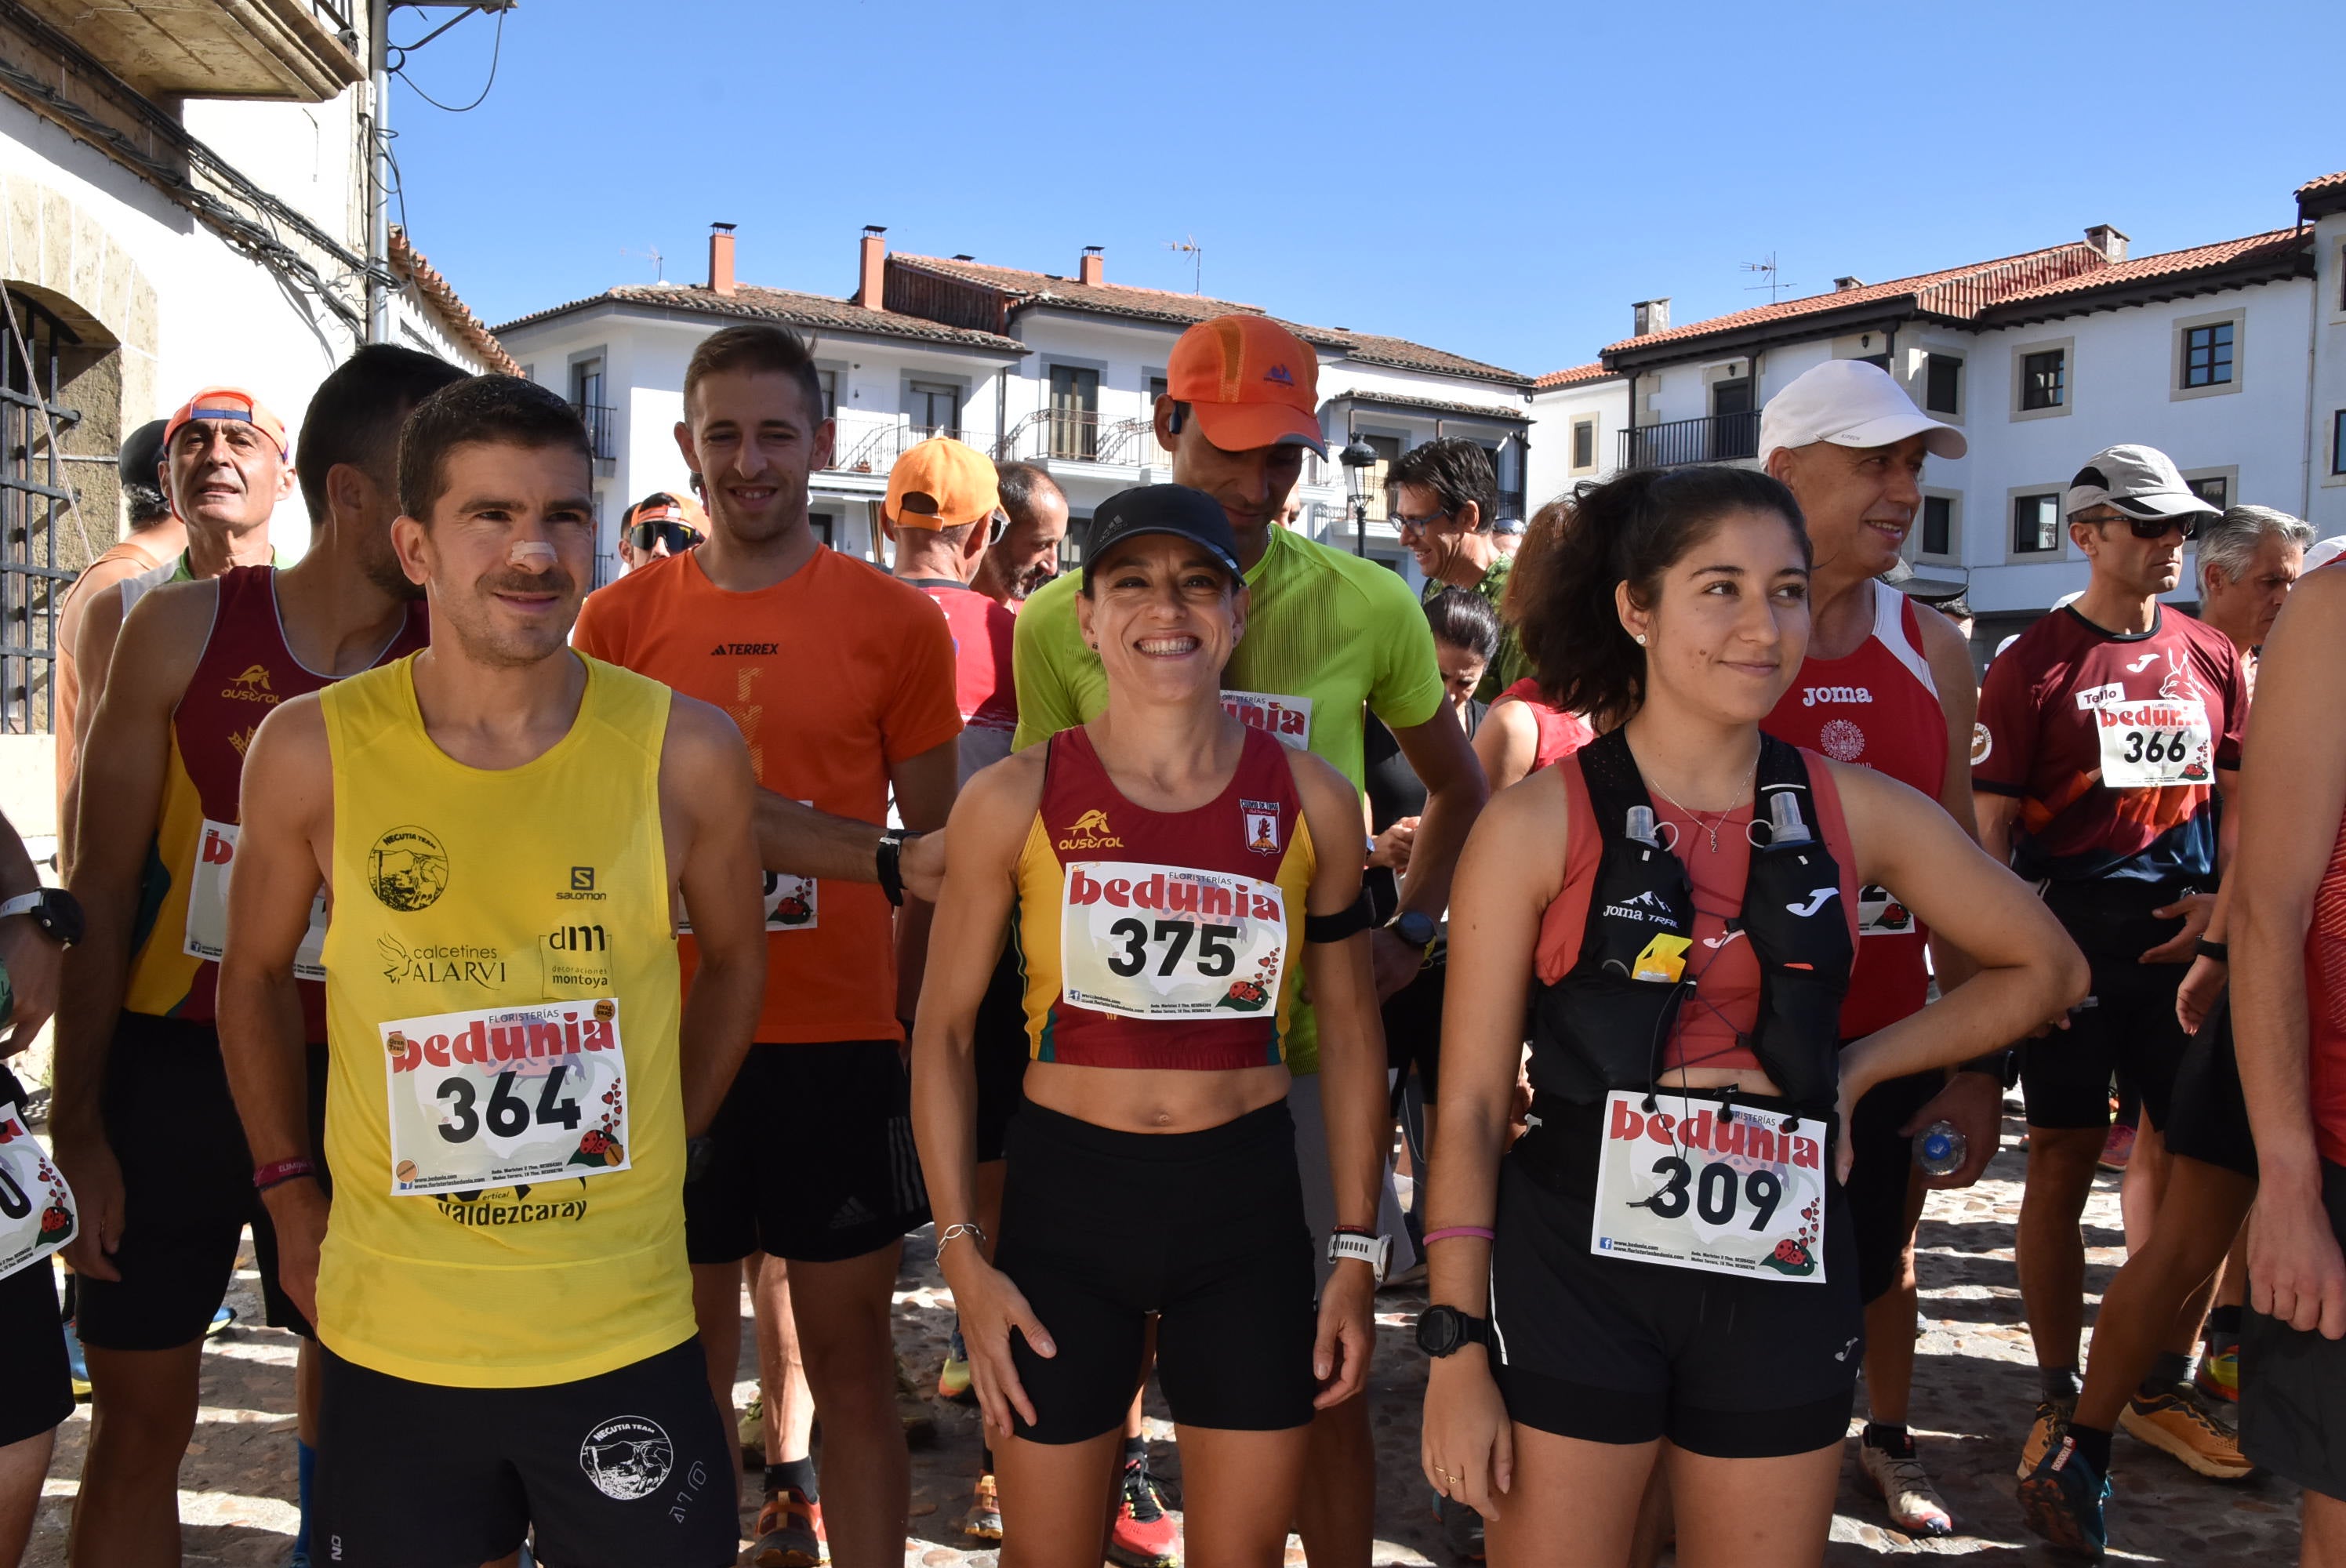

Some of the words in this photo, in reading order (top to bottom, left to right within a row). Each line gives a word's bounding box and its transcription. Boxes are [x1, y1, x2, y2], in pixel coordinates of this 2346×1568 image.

[728, 643, 779, 655] TERREX
[221, 689, 282, 704] austral
[1803, 686, 1872, 707] Joma
[2084, 690, 2117, 704] Tello
[2124, 731, 2186, 763] 366
[1059, 837, 1124, 850] austral
[1169, 871, 1233, 885] FLORISTERÍAS
[1070, 870, 1280, 923] bedunia
[1603, 905, 1643, 921] Joma
[1647, 913, 1679, 928] TRAIL
[414, 944, 496, 960] calcetines
[1107, 917, 1238, 977] 375
[412, 961, 506, 990] ALARVI
[552, 965, 608, 975] decoraciones
[553, 974, 608, 989] montoya
[488, 1009, 559, 1024] FLORISTERÍAS
[388, 1011, 616, 1073] bedunia
[438, 1065, 582, 1144] 364
[1610, 1100, 1819, 1170] bedunia
[1648, 1156, 1781, 1232] 309
[593, 1424, 630, 1441] NECUTIA
[631, 1424, 655, 1434] TEAM
